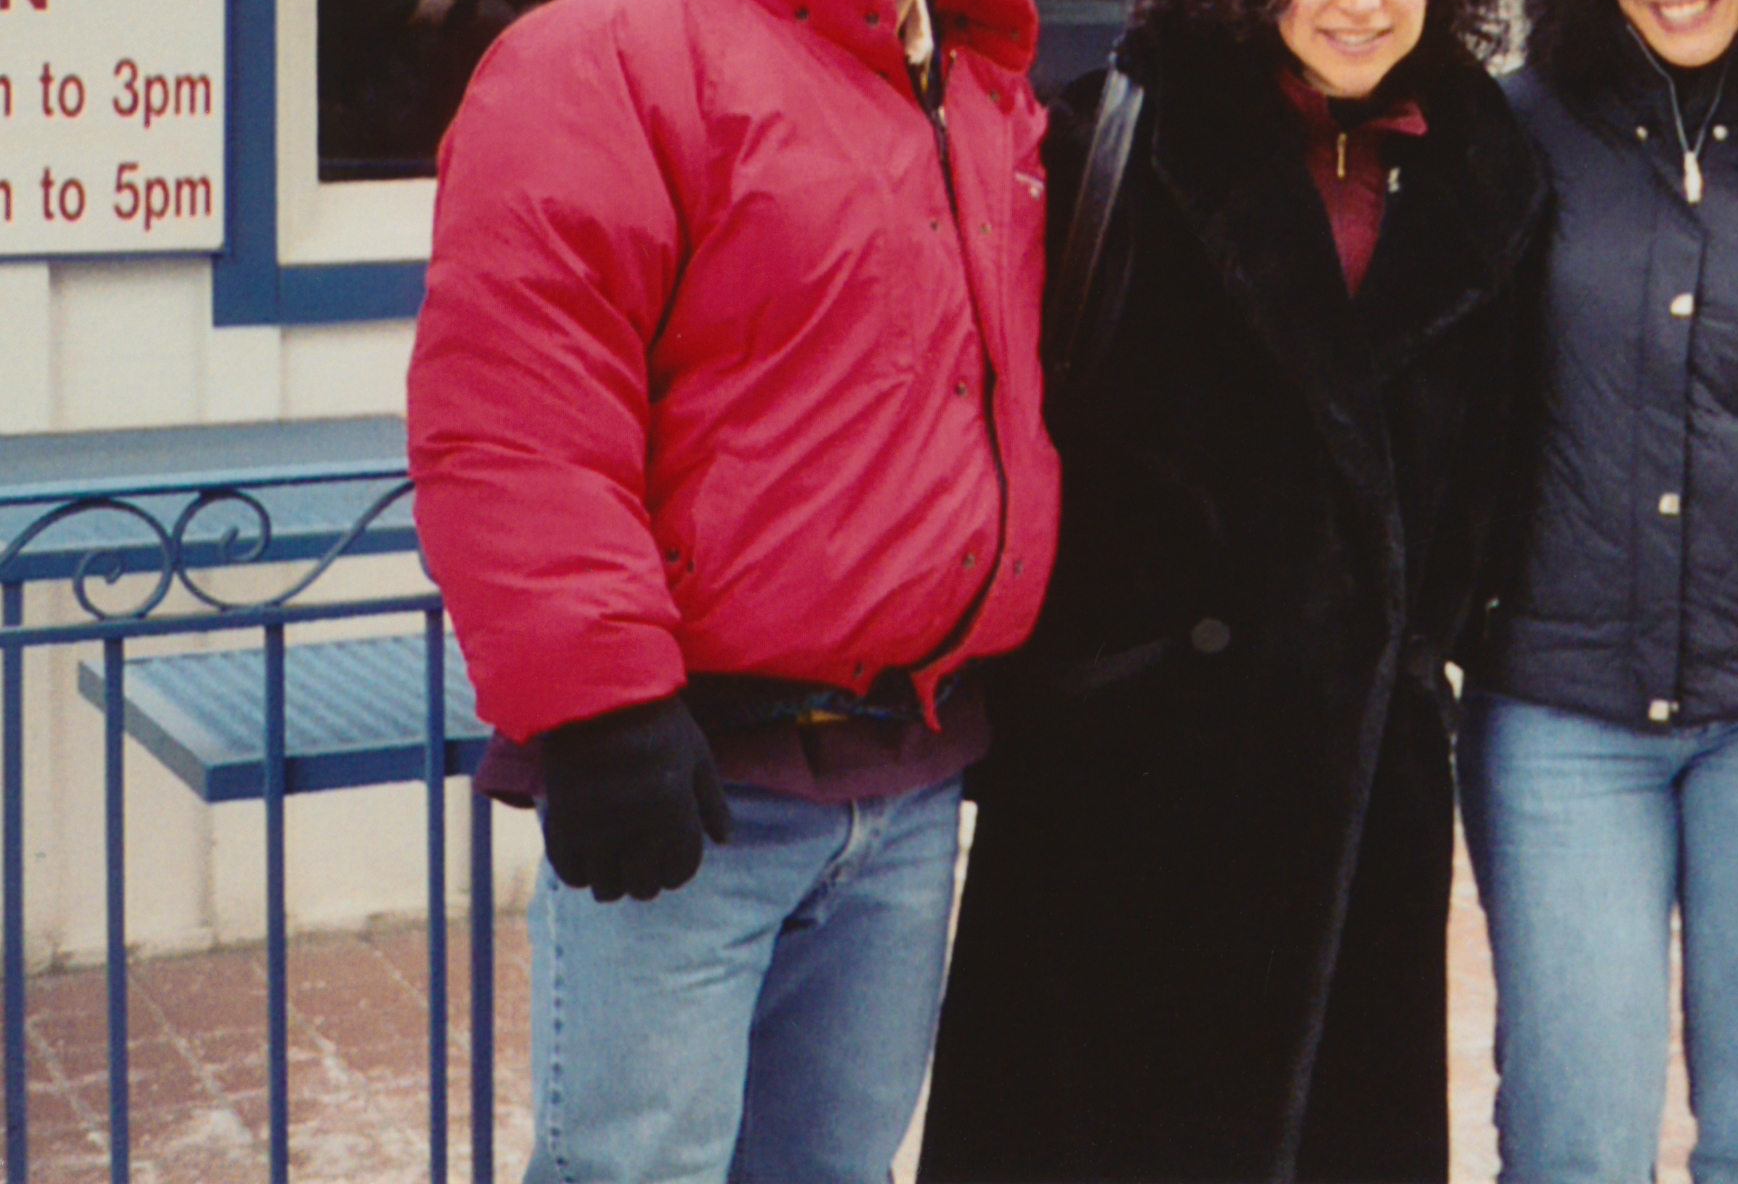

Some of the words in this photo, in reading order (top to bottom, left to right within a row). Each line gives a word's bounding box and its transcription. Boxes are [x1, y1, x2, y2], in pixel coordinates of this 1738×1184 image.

[39, 61, 85, 118] to
[112, 58, 212, 129] 3pm
[40, 166, 86, 222] to
[113, 162, 212, 231] 5pm
